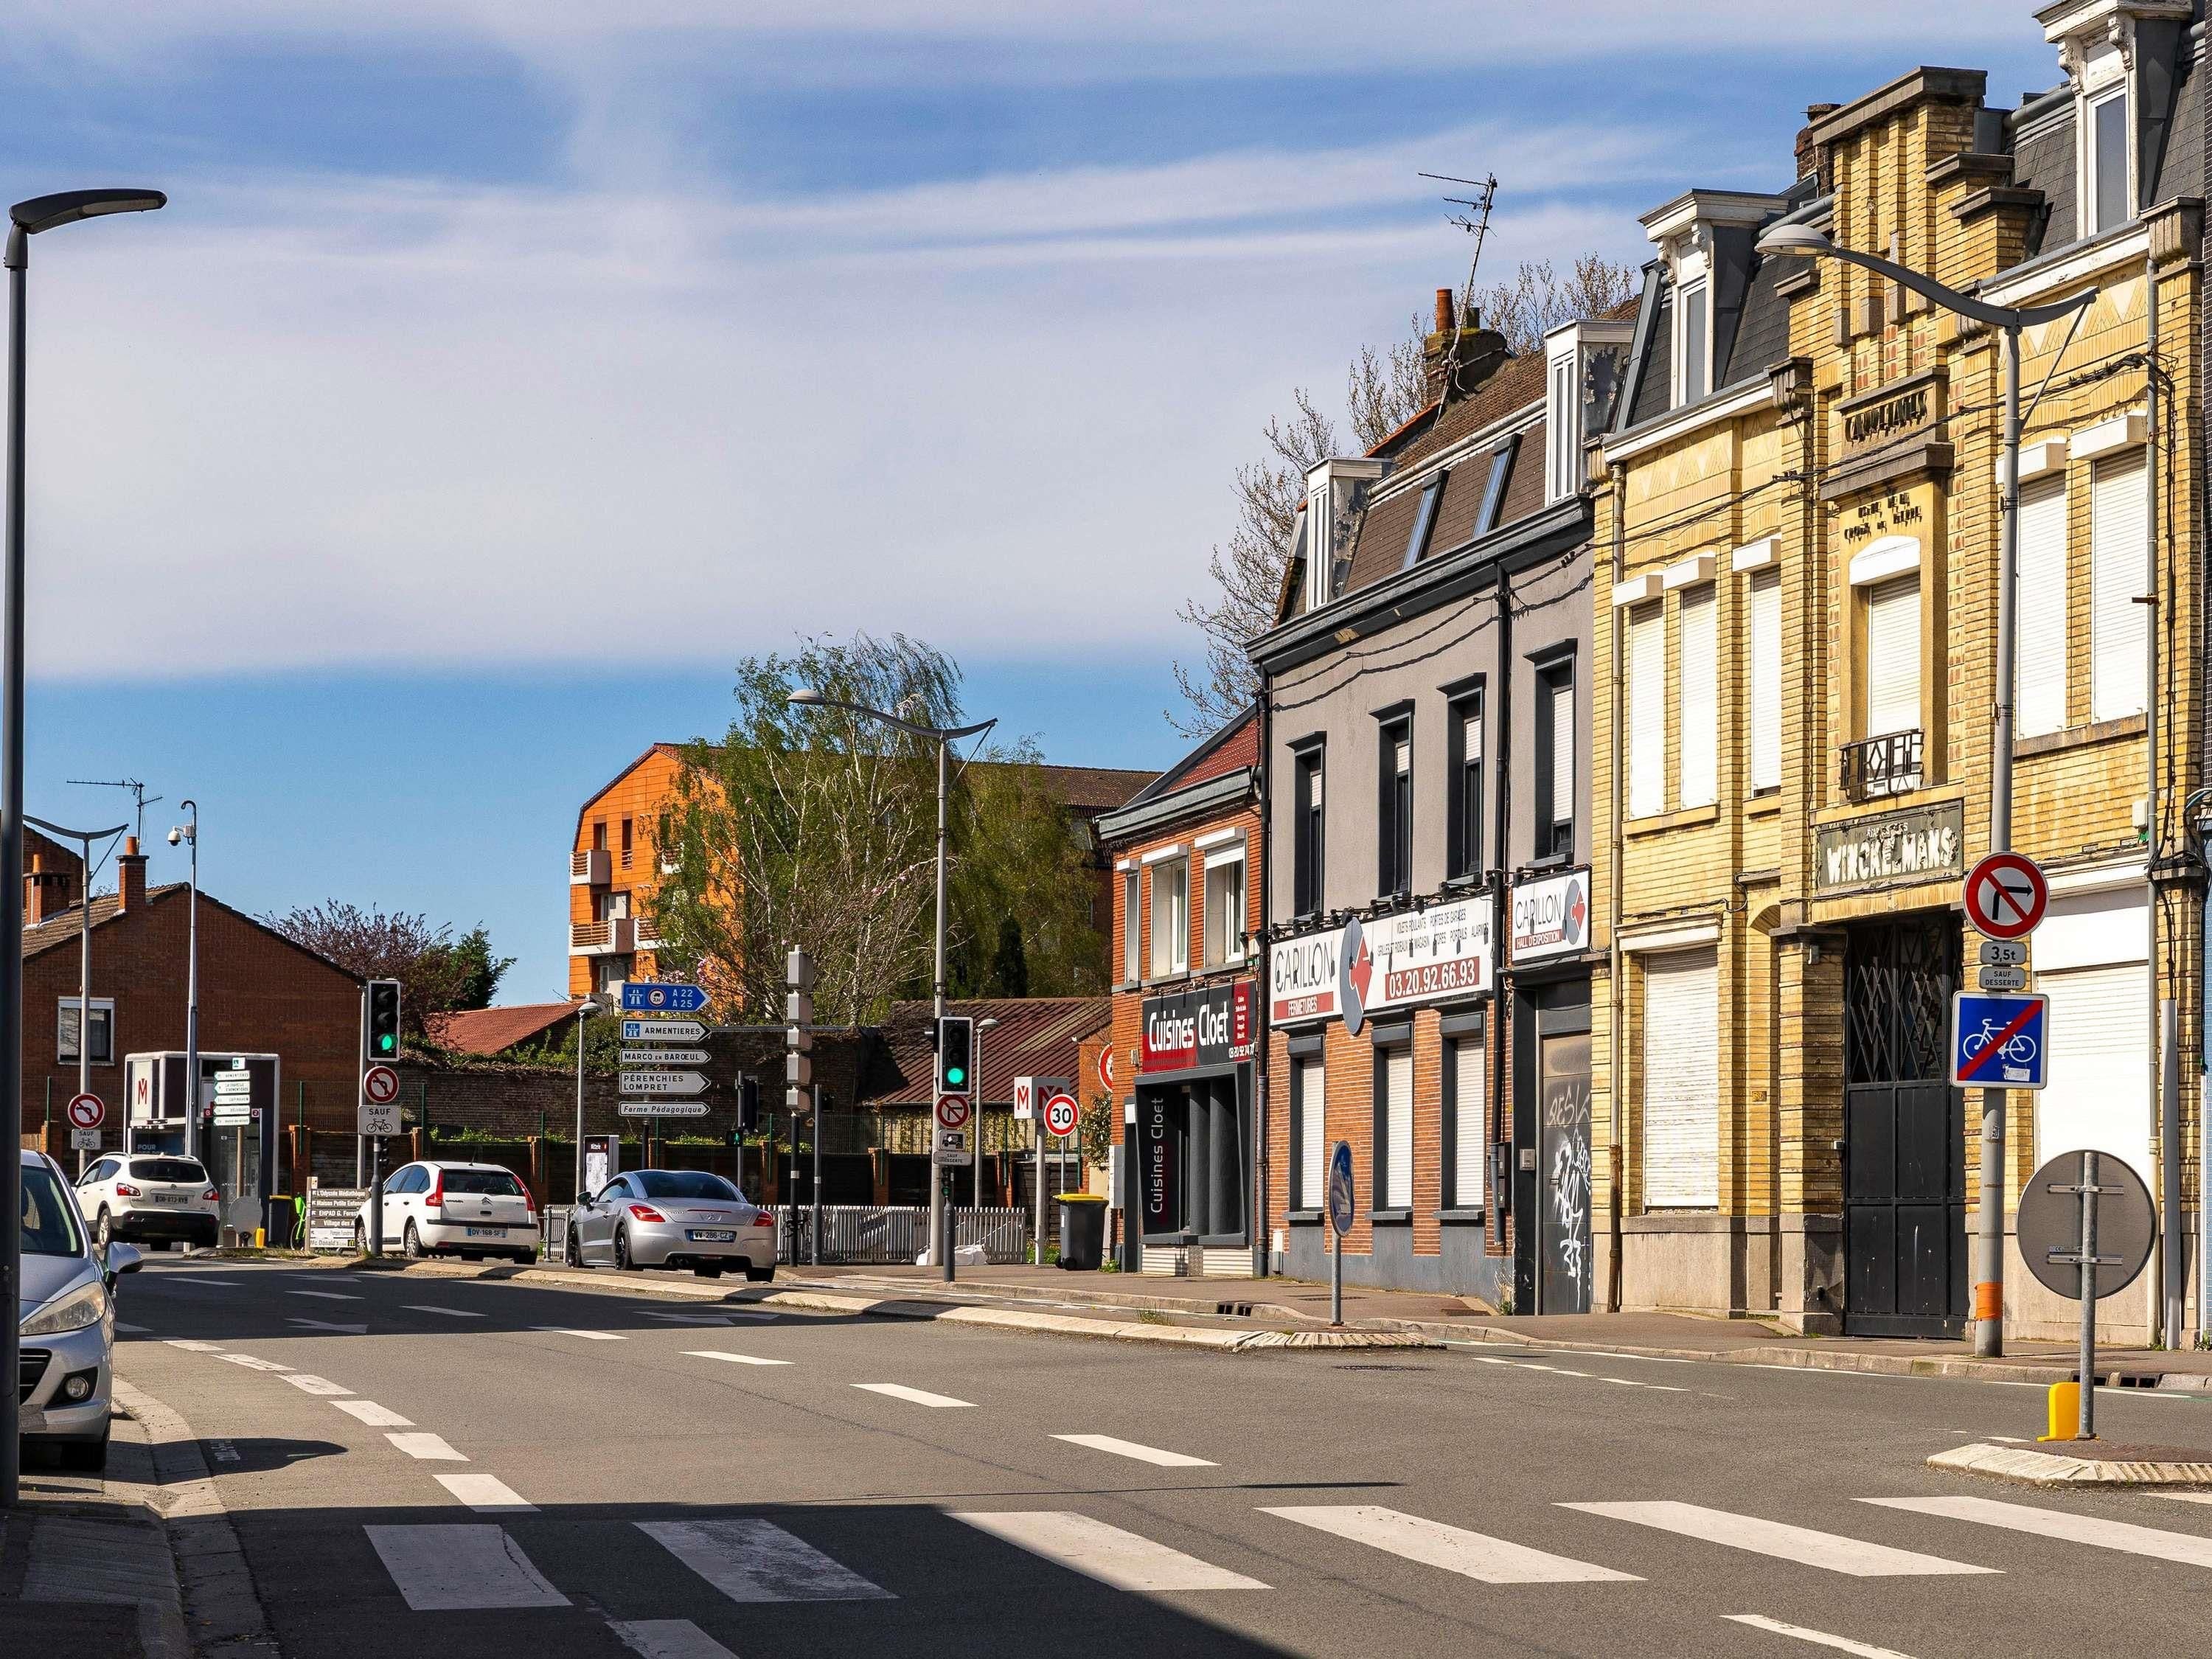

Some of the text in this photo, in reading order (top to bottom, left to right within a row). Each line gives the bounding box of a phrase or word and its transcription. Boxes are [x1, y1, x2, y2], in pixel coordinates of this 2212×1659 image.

[1515, 892, 1561, 930] CARILLON
[1471, 922, 1489, 937] ALARM
[1517, 936, 1528, 949] HALL
[1991, 946, 2016, 962] 3,5t
[1275, 940, 1333, 992] CARILLON
[1389, 959, 1475, 998] 03.20.92.66.93
[1985, 978, 2020, 987] DESSERTE
[672, 989, 693, 997] A 22
[672, 1000, 693, 1008] A 25
[644, 1027, 700, 1035] ARMENTIERES
[1150, 1001, 1228, 1052] Cuisines Cloet
[624, 1074, 684, 1082] PÉRENCHIES
[651, 1105, 701, 1114] Pédagogique
[1052, 1107, 1071, 1124] 30
[1151, 1097, 1164, 1139] Cloet
[1151, 1145, 1164, 1214] Cuisines
